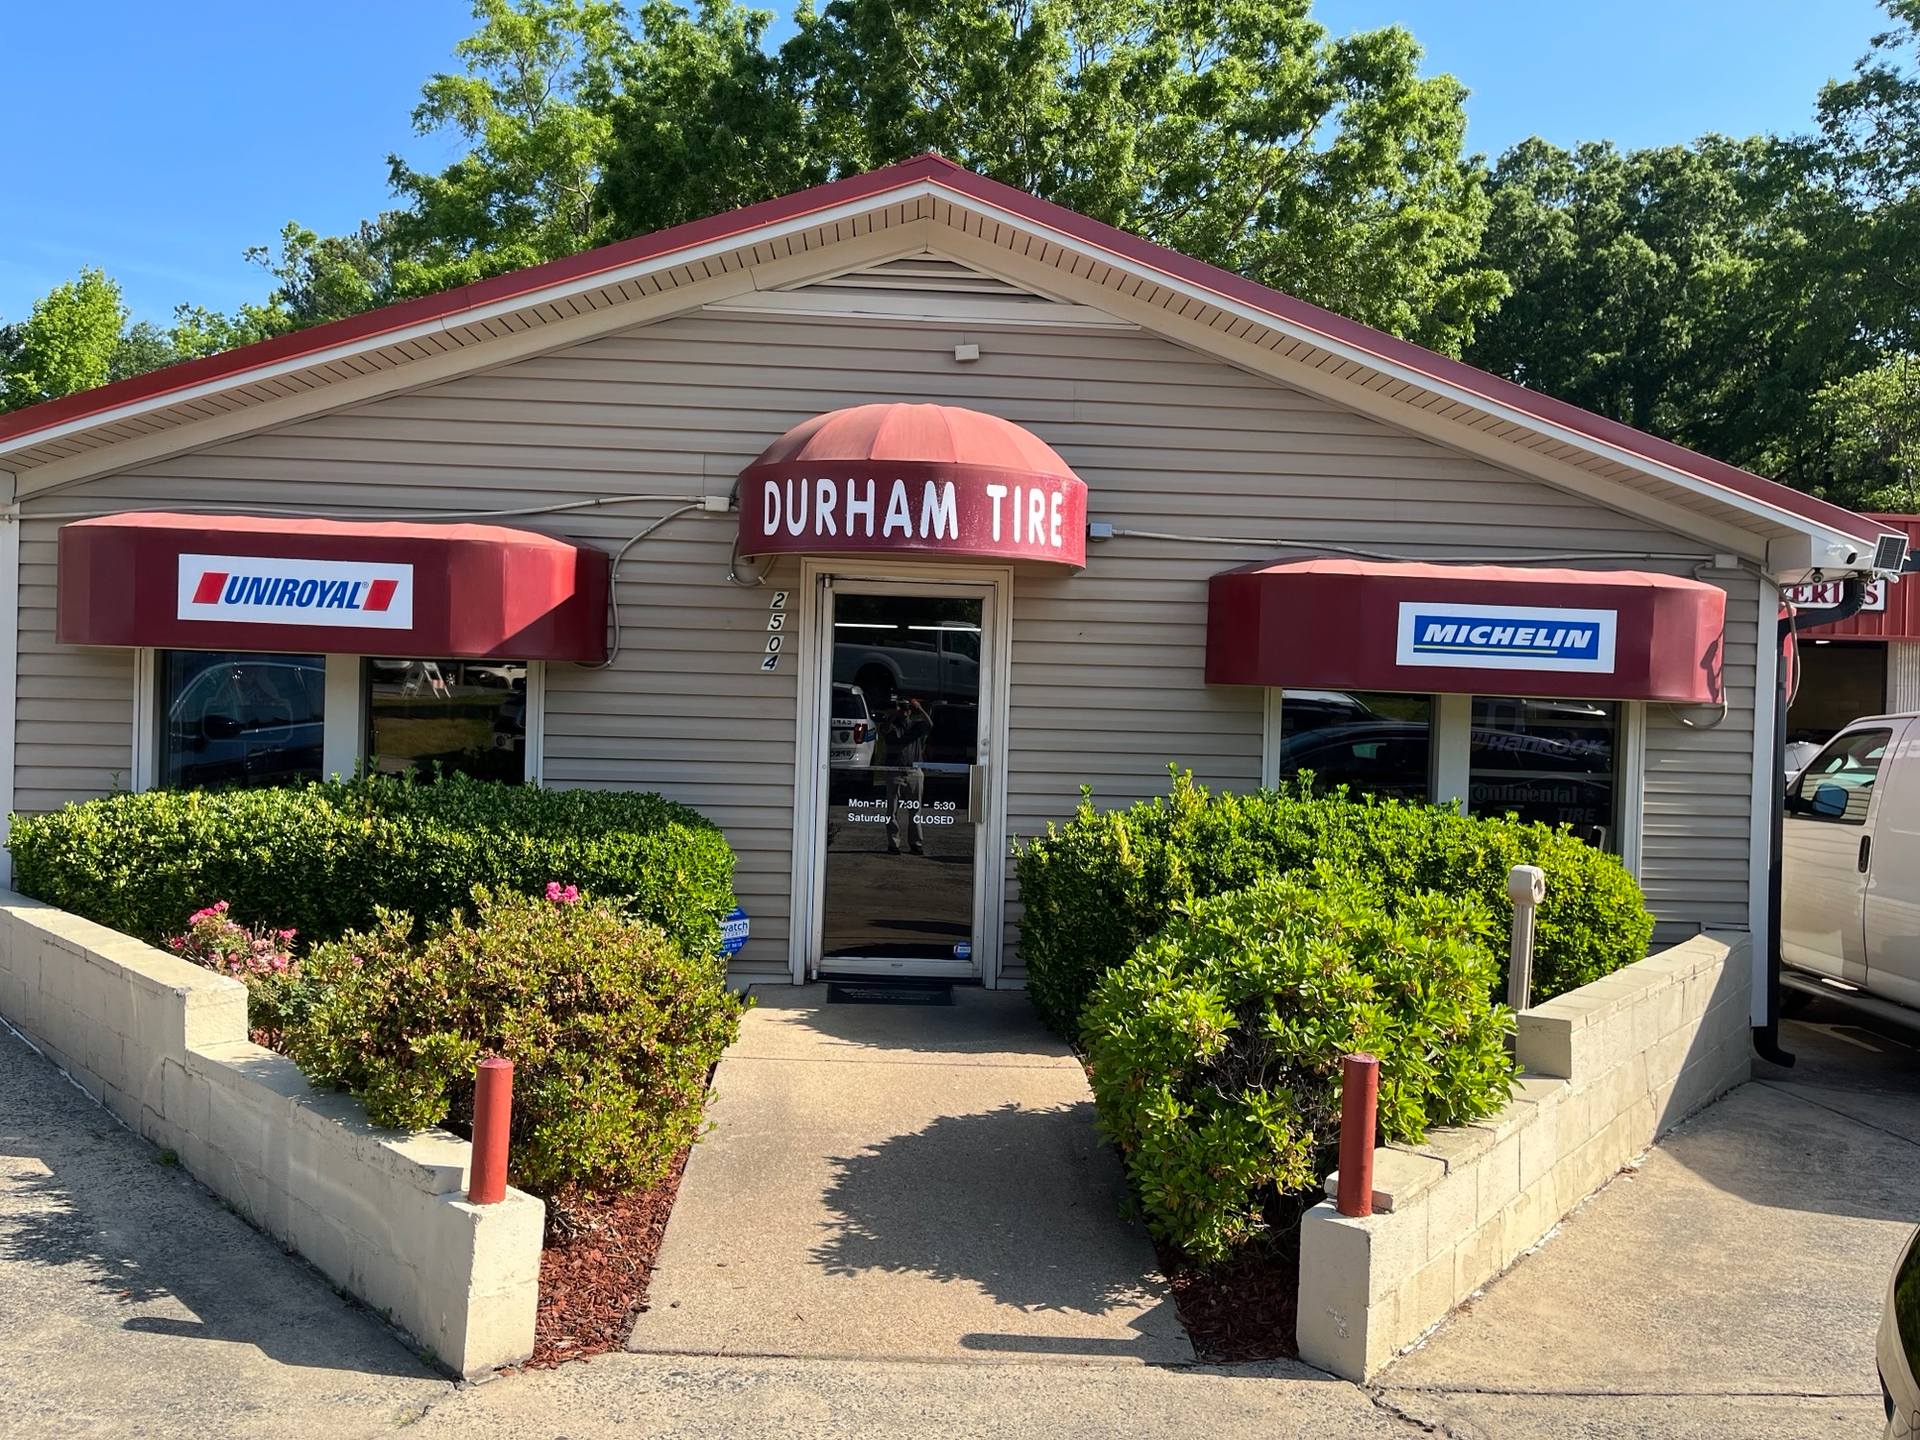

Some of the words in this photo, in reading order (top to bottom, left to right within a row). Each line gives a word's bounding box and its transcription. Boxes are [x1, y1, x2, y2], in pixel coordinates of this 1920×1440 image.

[763, 477, 959, 541] DURHAM
[986, 484, 1063, 548] TIRE
[224, 575, 362, 610] UNIROYAL
[1792, 582, 1879, 606] ERIS
[763, 592, 786, 670] 2504
[1422, 623, 1593, 649] MICHELIN
[848, 798, 888, 809] Mon-Fri
[898, 799, 920, 810] 7:30
[933, 801, 956, 811] 5:30
[1470, 783, 1578, 804] Continental
[847, 812, 892, 825] Saturday
[912, 814, 954, 825] CLOSED
[1557, 806, 1597, 823] TIRE
